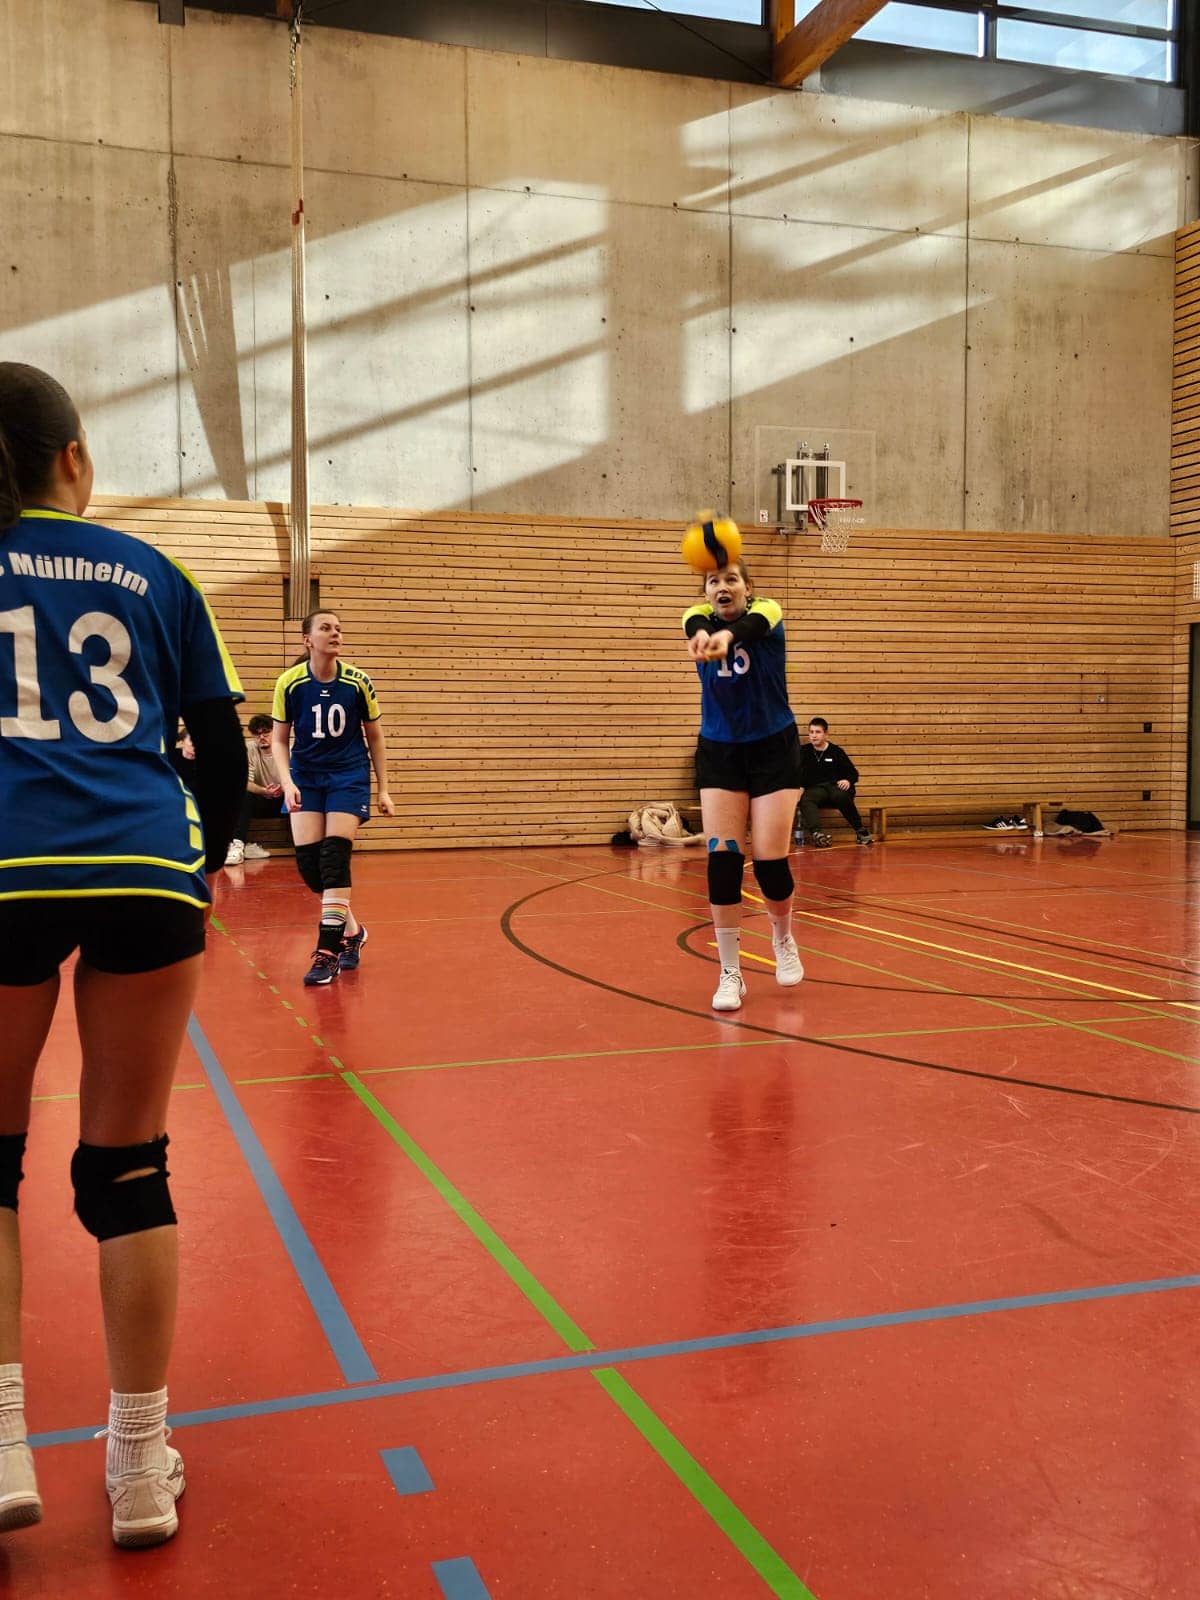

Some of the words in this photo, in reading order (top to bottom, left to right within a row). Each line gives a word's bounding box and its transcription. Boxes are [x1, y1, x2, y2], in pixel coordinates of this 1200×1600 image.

[8, 552, 149, 596] Müllheim
[0, 605, 140, 744] 13
[311, 703, 347, 739] 10
